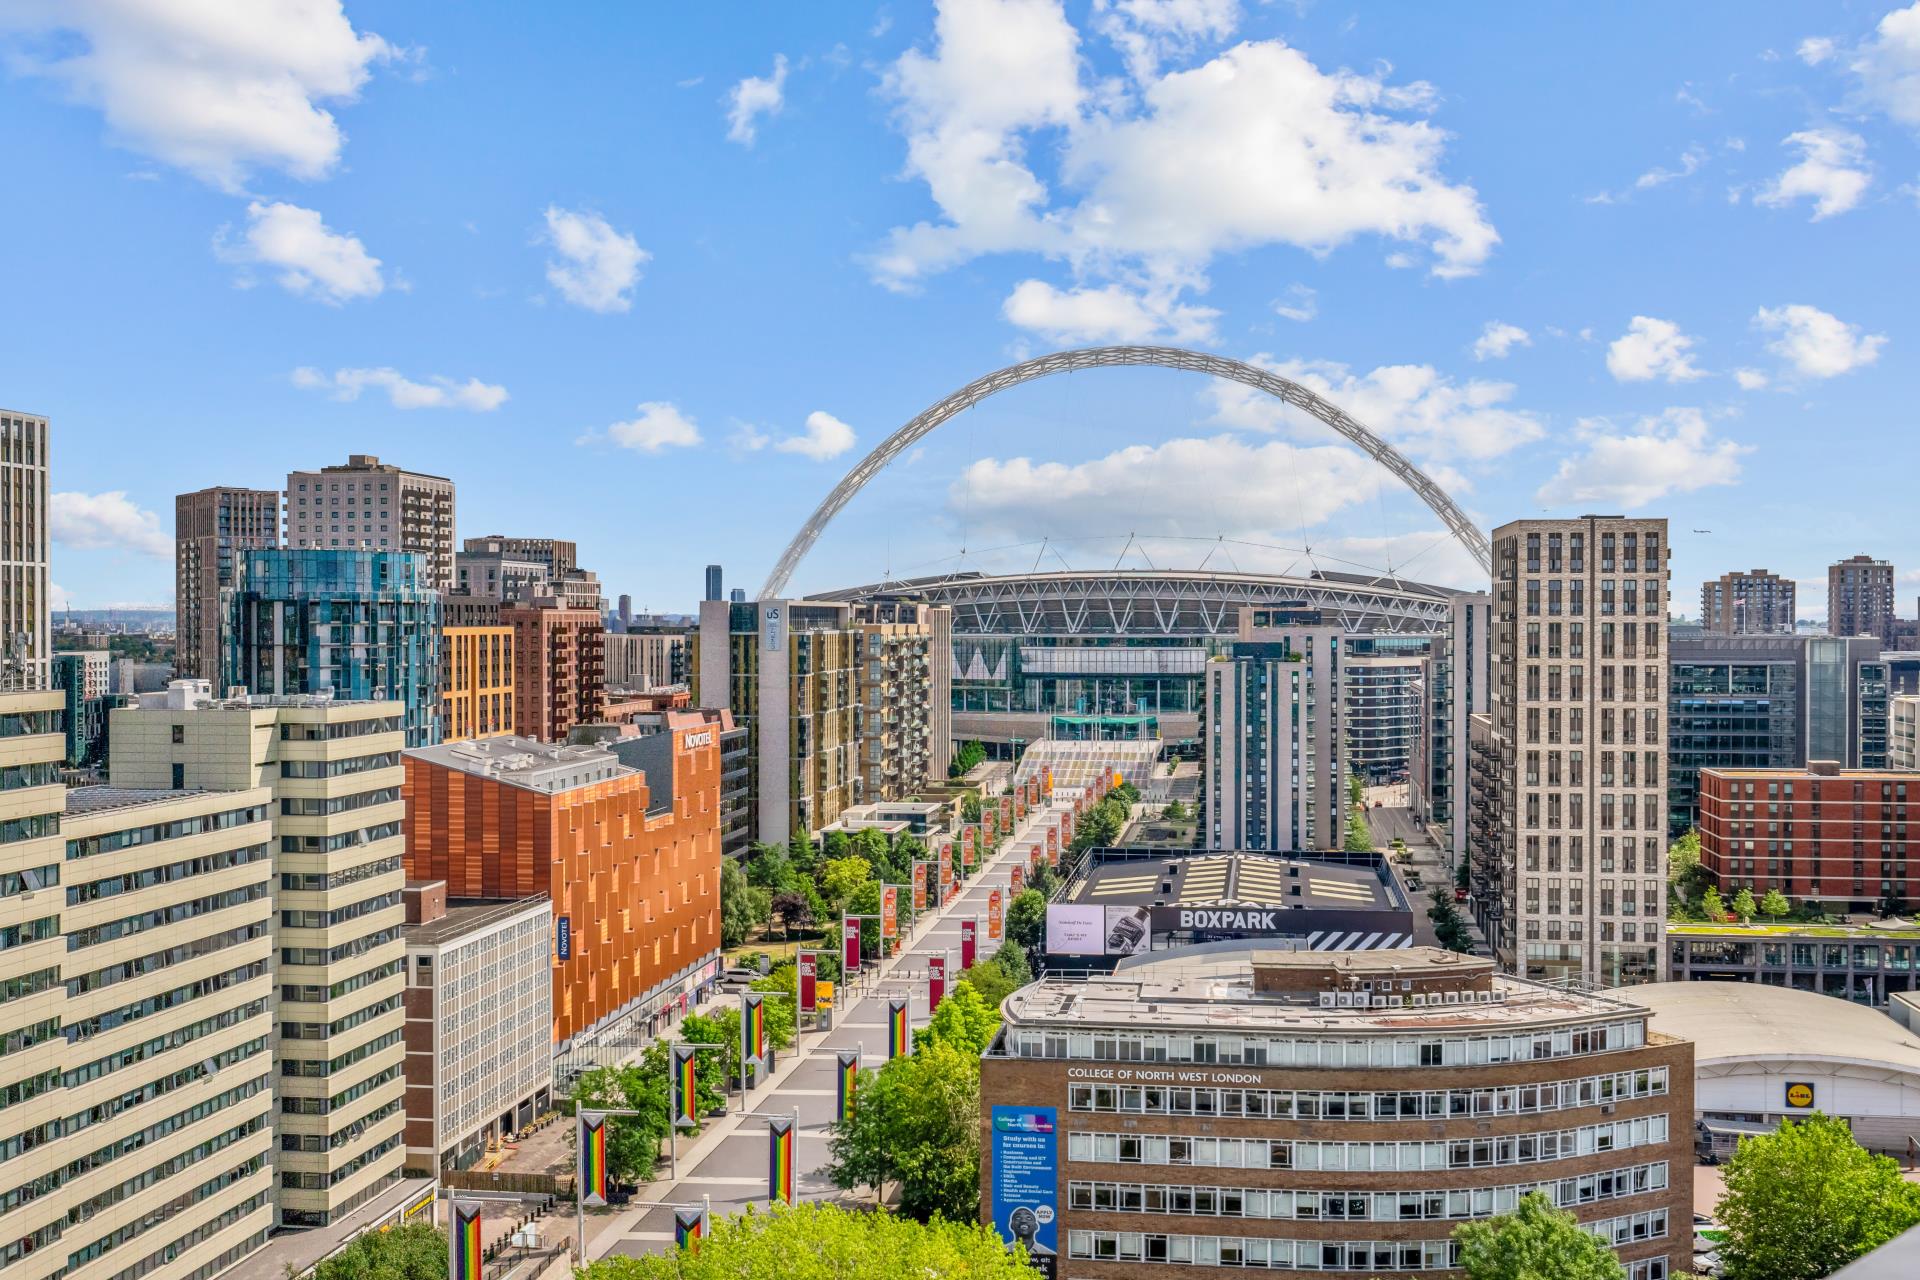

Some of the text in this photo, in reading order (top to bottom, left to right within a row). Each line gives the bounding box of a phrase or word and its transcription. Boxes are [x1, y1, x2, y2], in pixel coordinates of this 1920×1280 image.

[685, 729, 713, 749] NOVOTEL
[1180, 910, 1277, 930] BOXPARK
[560, 919, 568, 955] NOVOTEL
[1068, 1067, 1261, 1084] COLLEGE OF NORTH WEST LONDON
